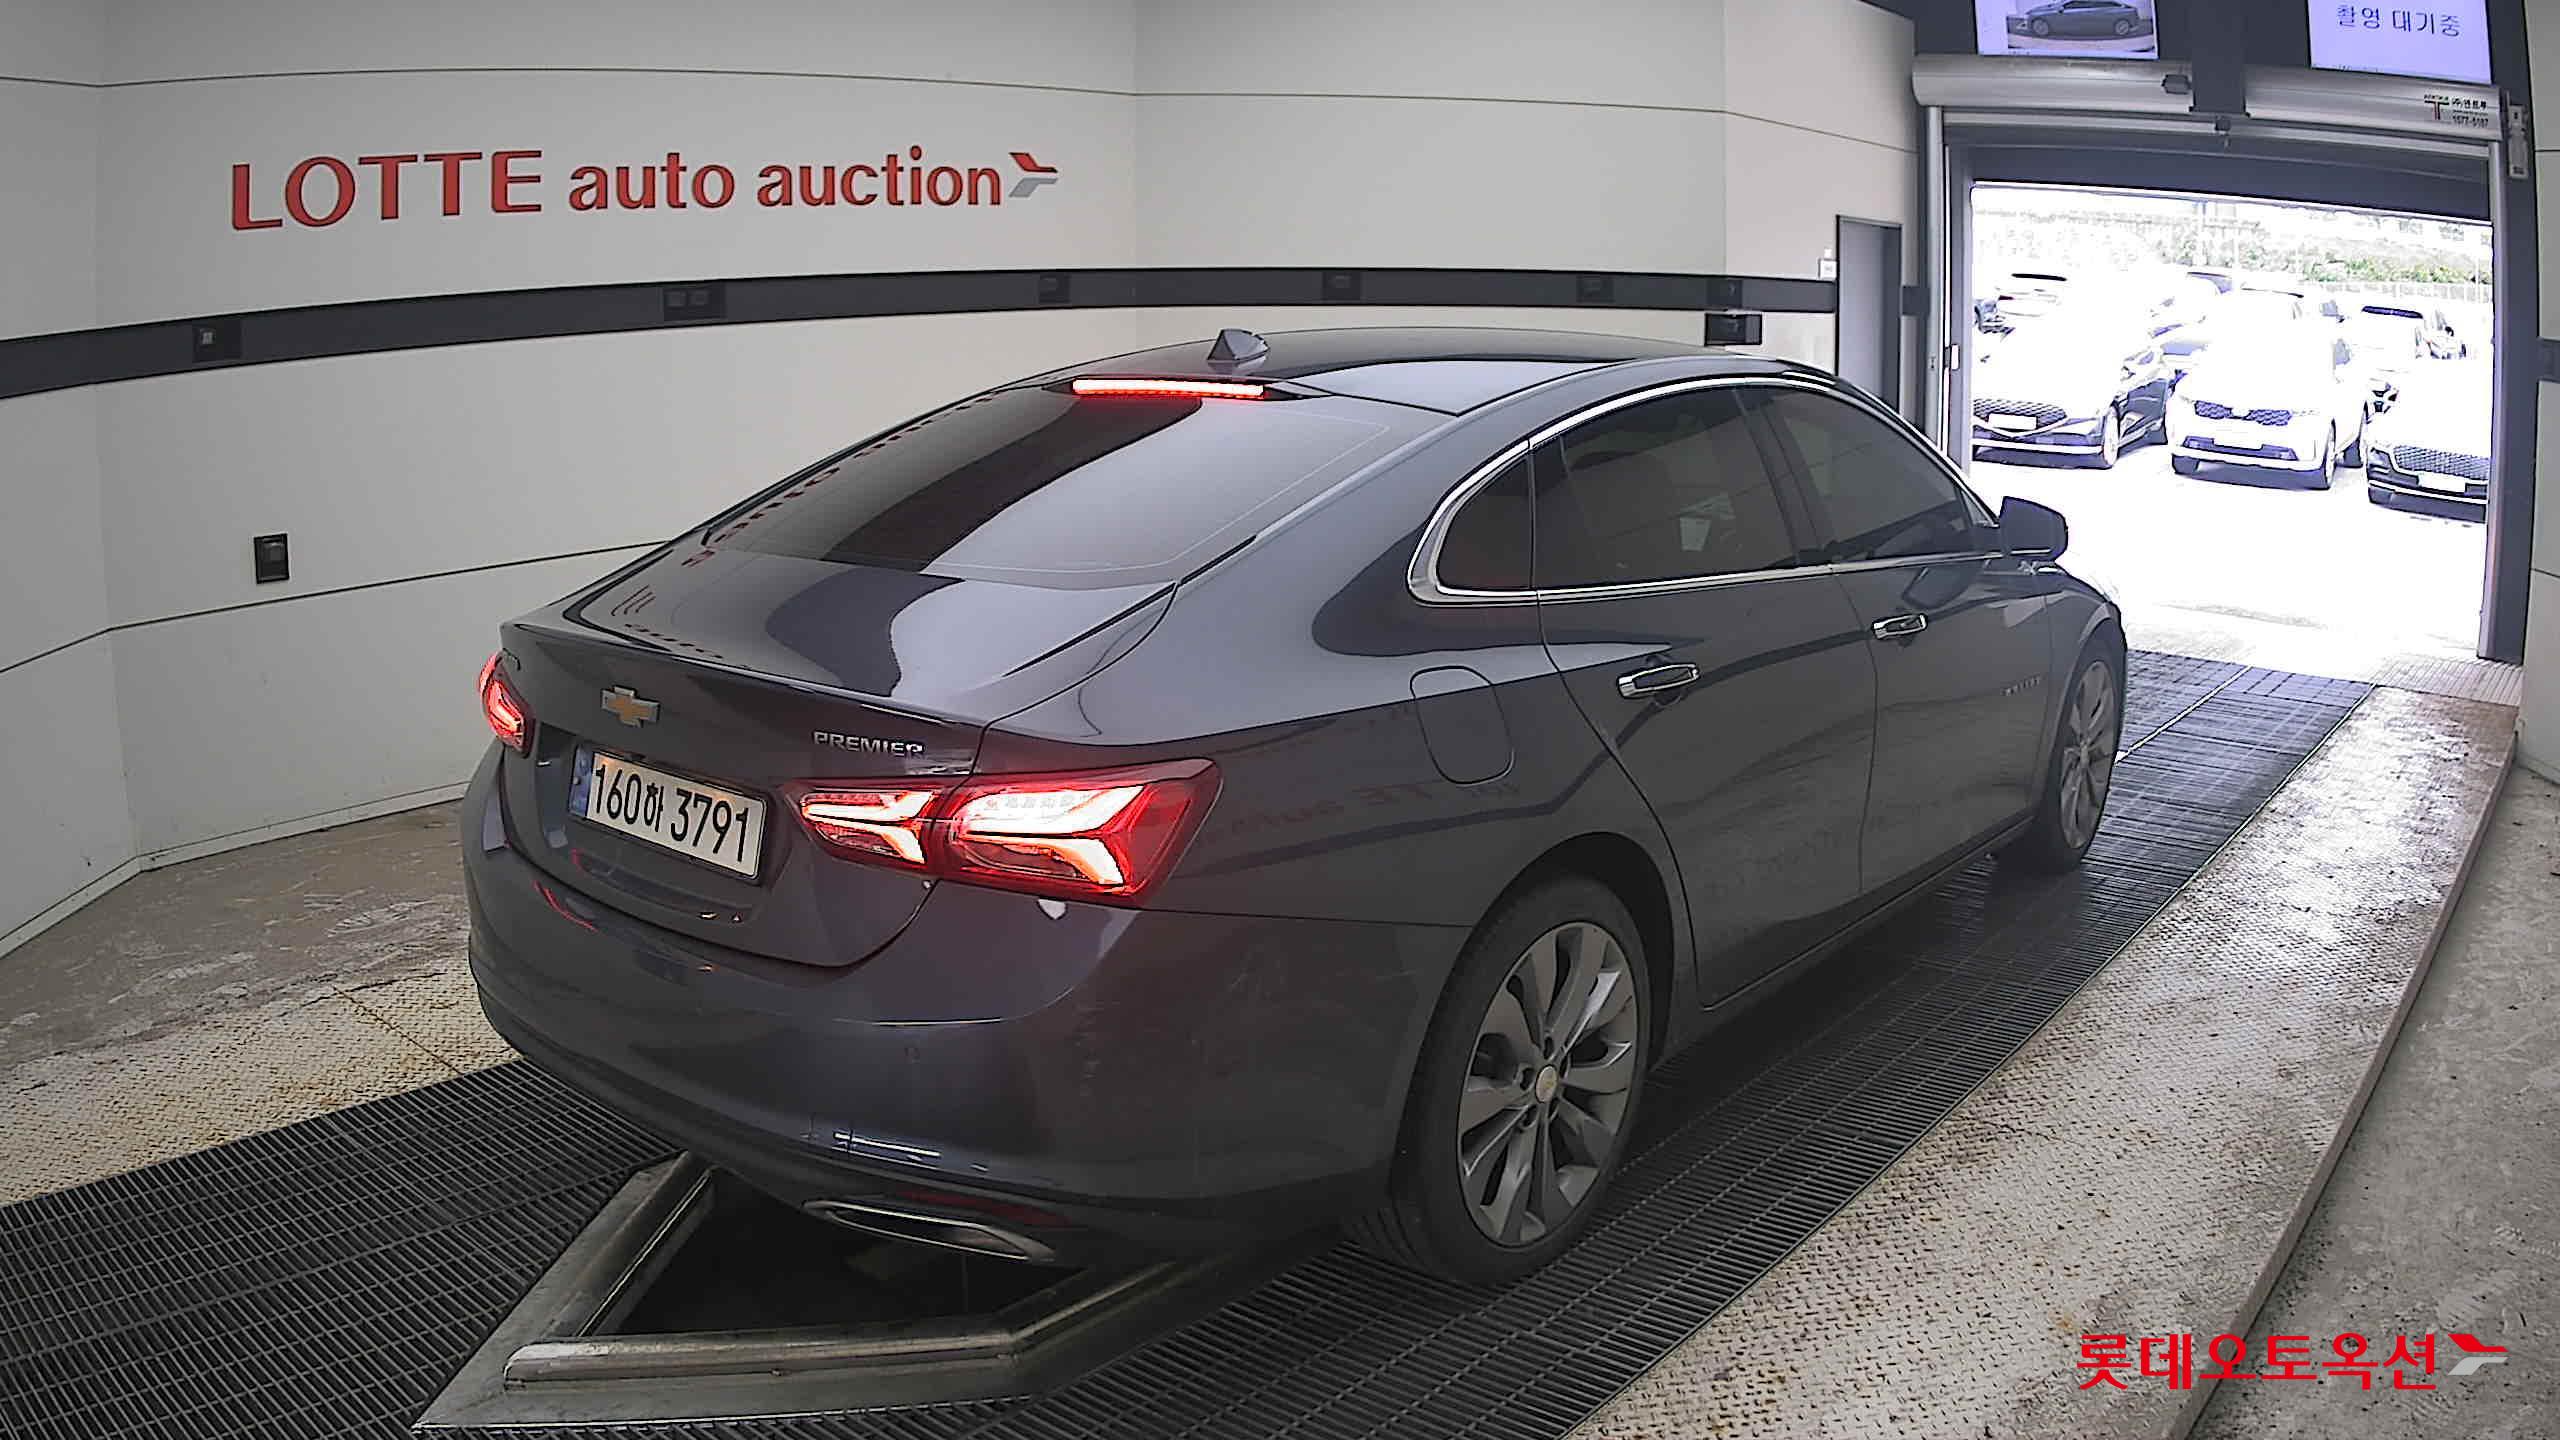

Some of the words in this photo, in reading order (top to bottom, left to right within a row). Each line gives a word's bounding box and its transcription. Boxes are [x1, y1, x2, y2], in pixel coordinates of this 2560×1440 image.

[2337, 5, 2381, 30] 촬영
[2392, 10, 2461, 38] 대기중
[232, 151, 542, 230] LOTTE
[569, 154, 736, 210] auto
[757, 146, 1003, 207] auction
[813, 730, 926, 758] PREMIER
[595, 763, 665, 833] 160하
[670, 787, 750, 863] 3791
